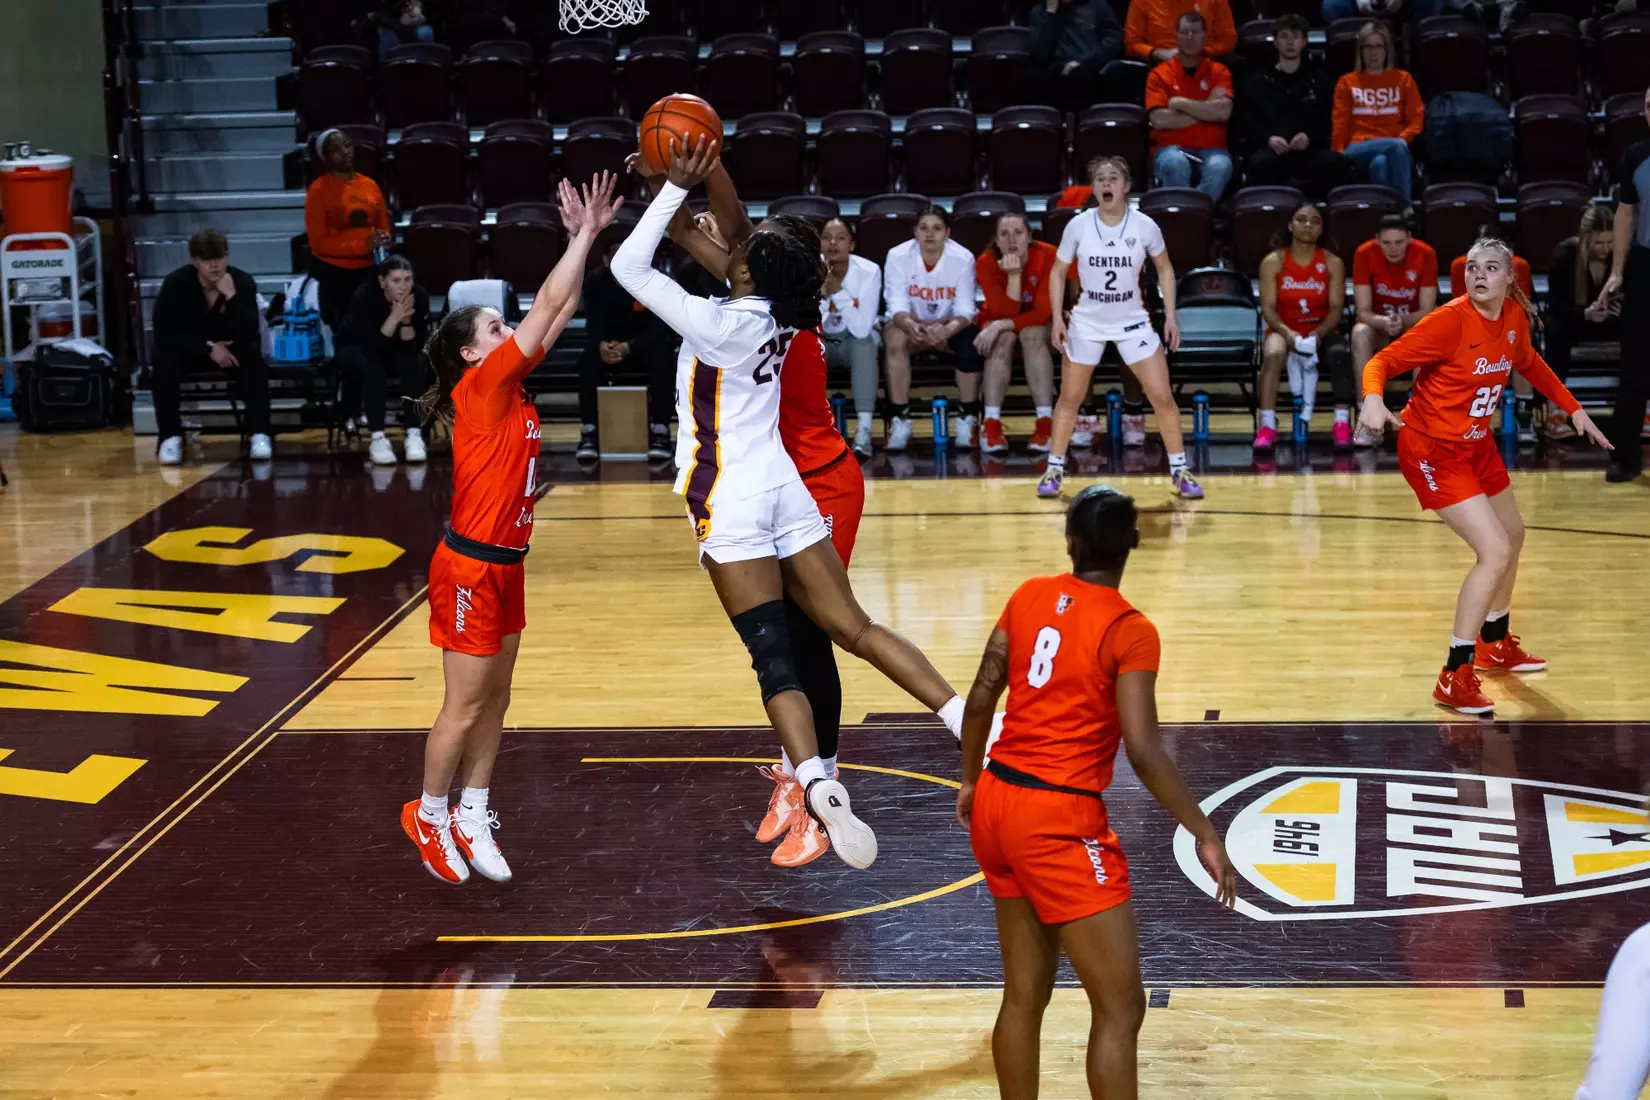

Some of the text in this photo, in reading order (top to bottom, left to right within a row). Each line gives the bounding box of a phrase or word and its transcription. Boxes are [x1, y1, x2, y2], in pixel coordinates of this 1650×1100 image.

[1351, 86, 1401, 106] BGSU
[11, 259, 64, 269] GATORADE
[1088, 256, 1134, 268] CENTRAL
[1104, 270, 1117, 291] 2
[1281, 276, 1326, 295] Bowling
[1087, 289, 1134, 304] MICHIGAN
[1299, 298, 1310, 314] 1
[1472, 354, 1513, 377] Bowling
[1469, 384, 1502, 418] 22
[456, 583, 473, 634] Falcons
[1026, 625, 1063, 690] 8
[1272, 818, 1321, 857] 1946
